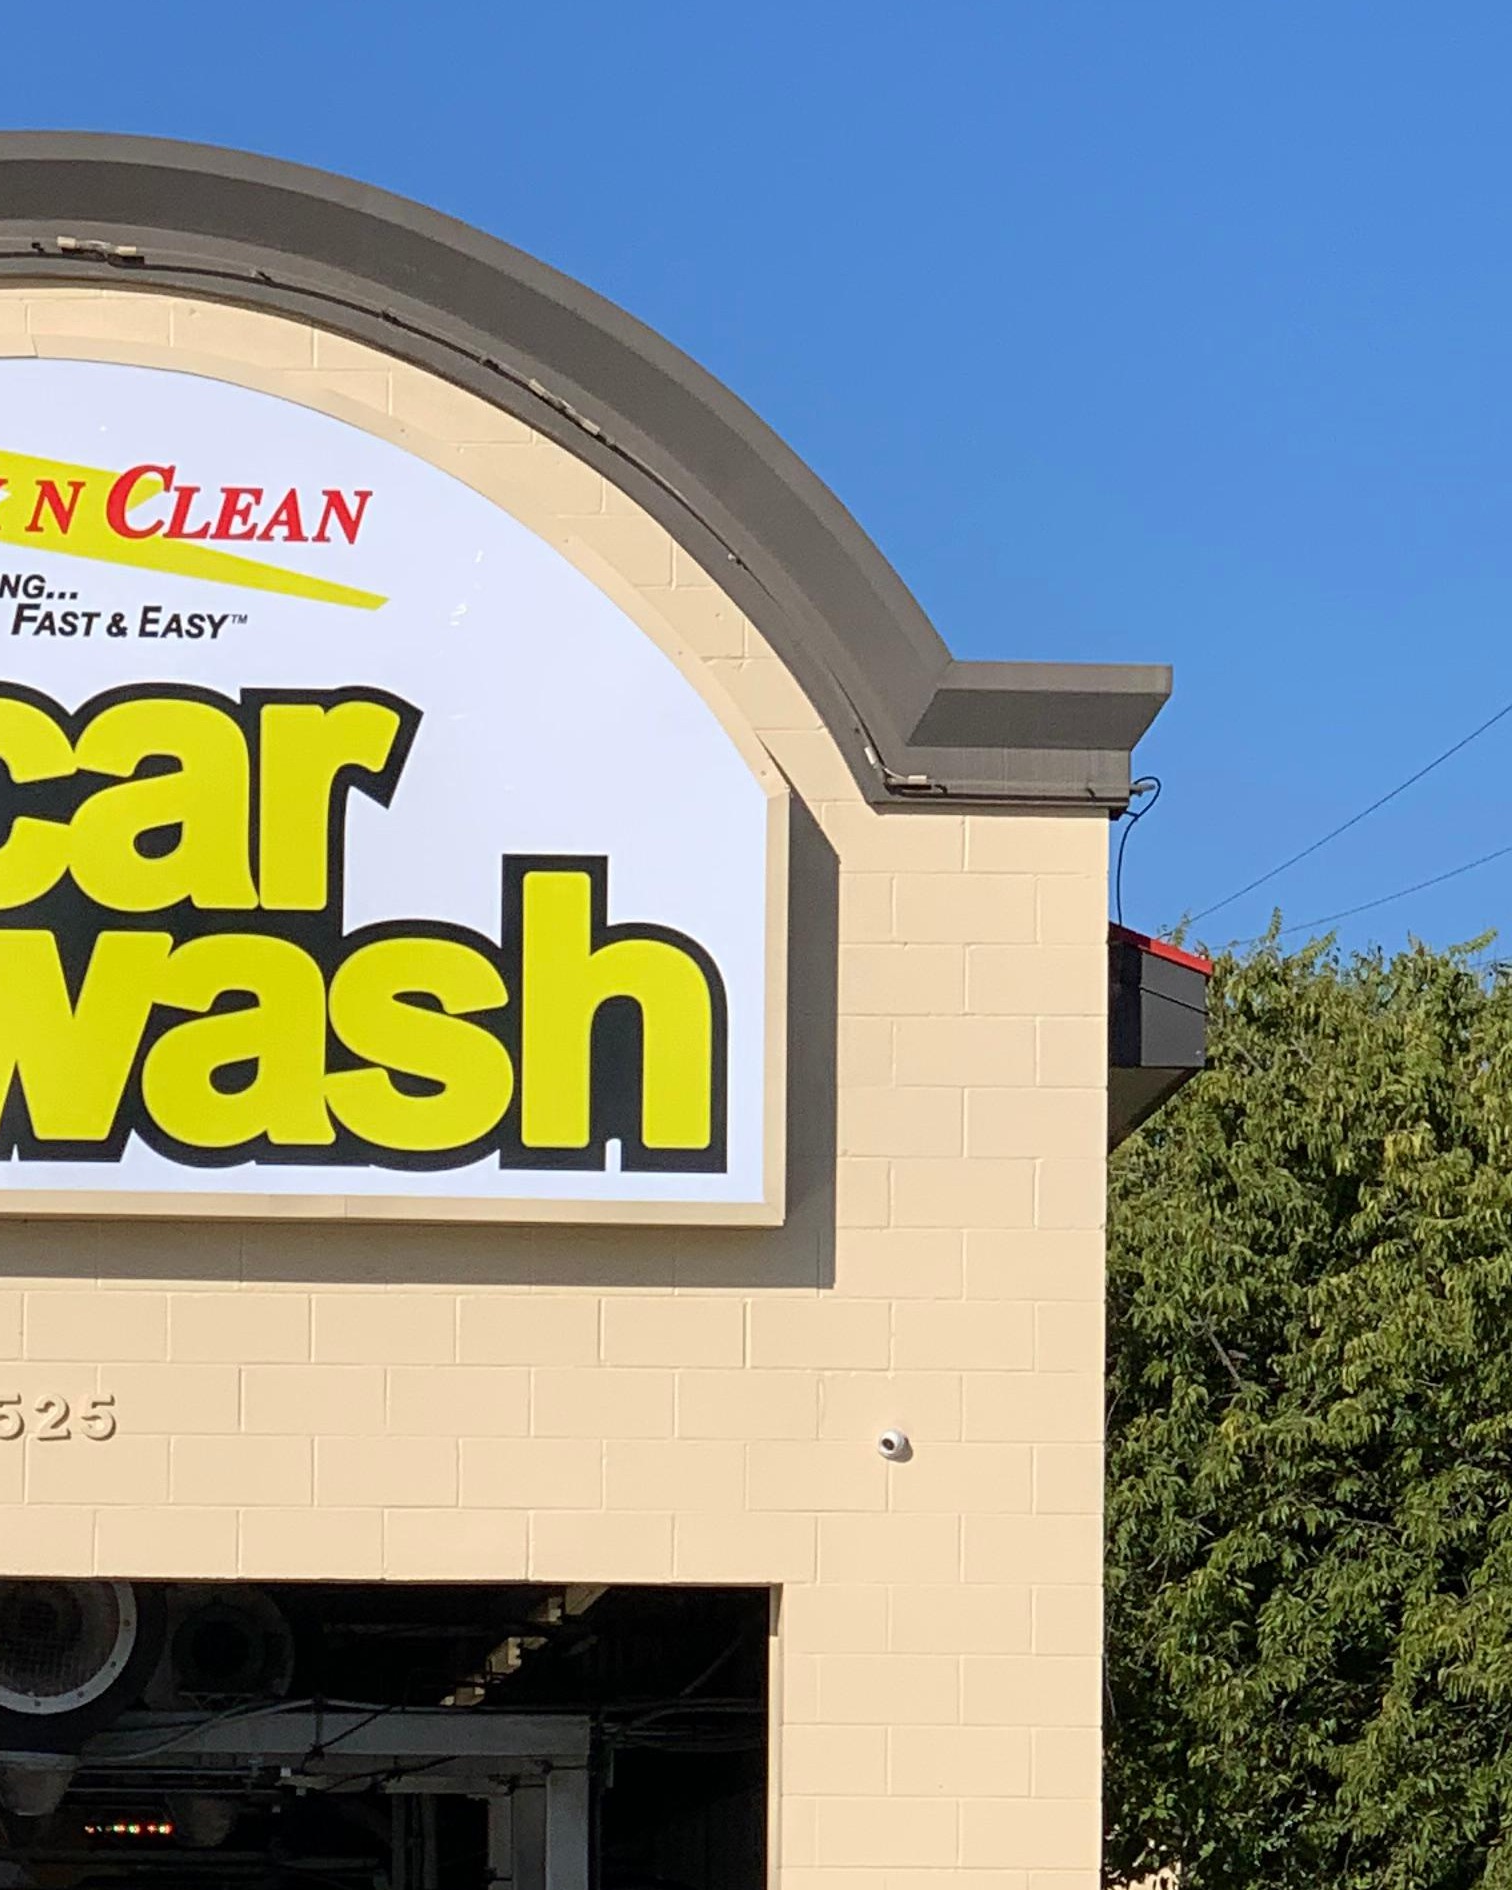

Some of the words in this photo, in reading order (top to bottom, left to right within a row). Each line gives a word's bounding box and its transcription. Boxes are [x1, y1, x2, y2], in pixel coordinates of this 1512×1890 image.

[26, 480, 86, 534] N
[106, 464, 373, 545] CLEAN
[11, 603, 101, 637] FAST
[105, 612, 129, 638] &
